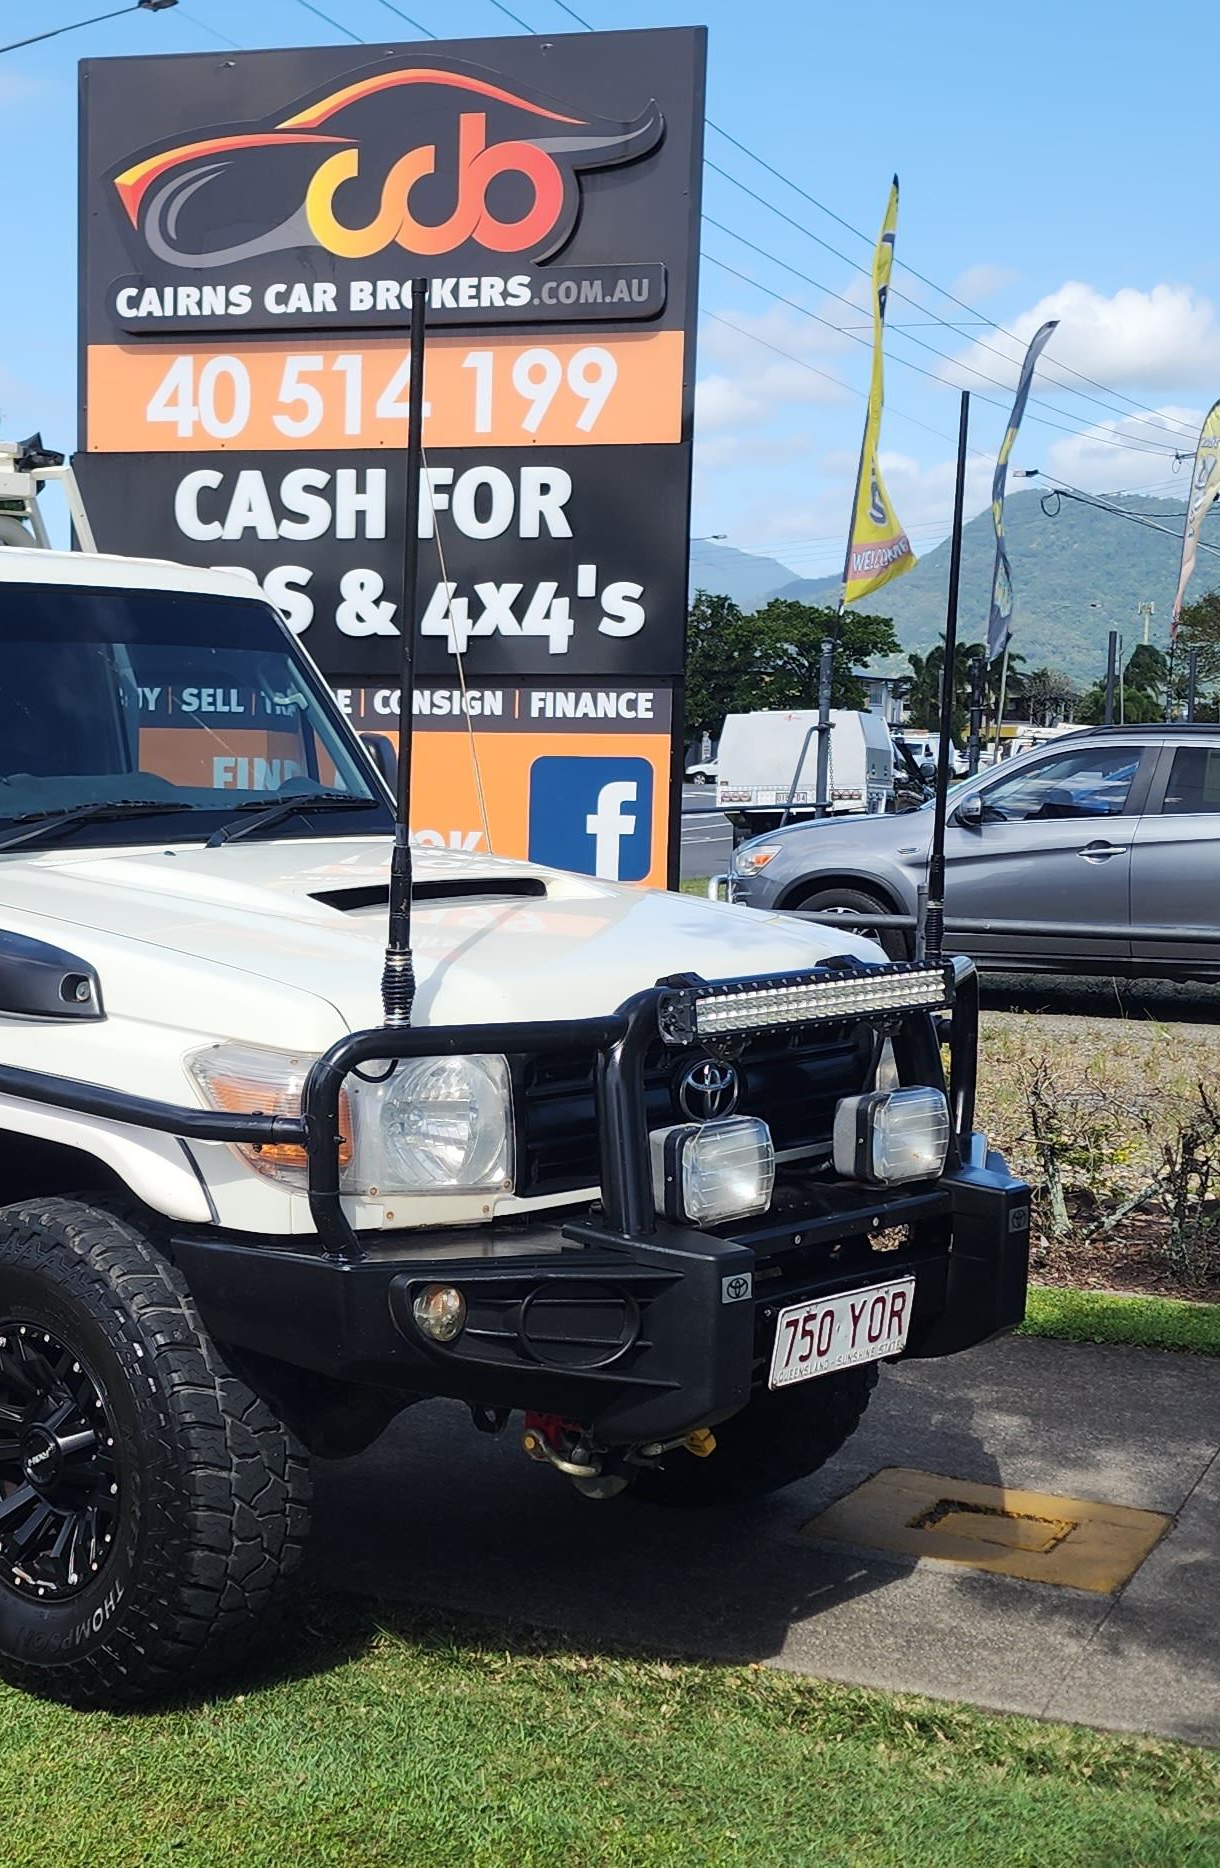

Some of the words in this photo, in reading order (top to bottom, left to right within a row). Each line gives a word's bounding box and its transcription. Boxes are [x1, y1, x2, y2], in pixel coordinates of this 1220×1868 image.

[115, 284, 253, 318] CAIRNS
[264, 281, 338, 315] CAR
[146, 355, 252, 438] 40
[271, 352, 432, 438] 514
[460, 346, 619, 434] 199
[174, 468, 387, 542] CASH
[416, 465, 574, 540] FOR
[335, 568, 402, 637] &
[181, 687, 245, 714] SELL
[373, 688, 503, 717] CONSIGN
[530, 690, 655, 719] FINANCE
[784, 1308, 836, 1369] 750
[848, 1290, 907, 1350] YOR
[778, 1358, 830, 1384] QUEENSLAND
[836, 1345, 877, 1367] SUNSHINE
